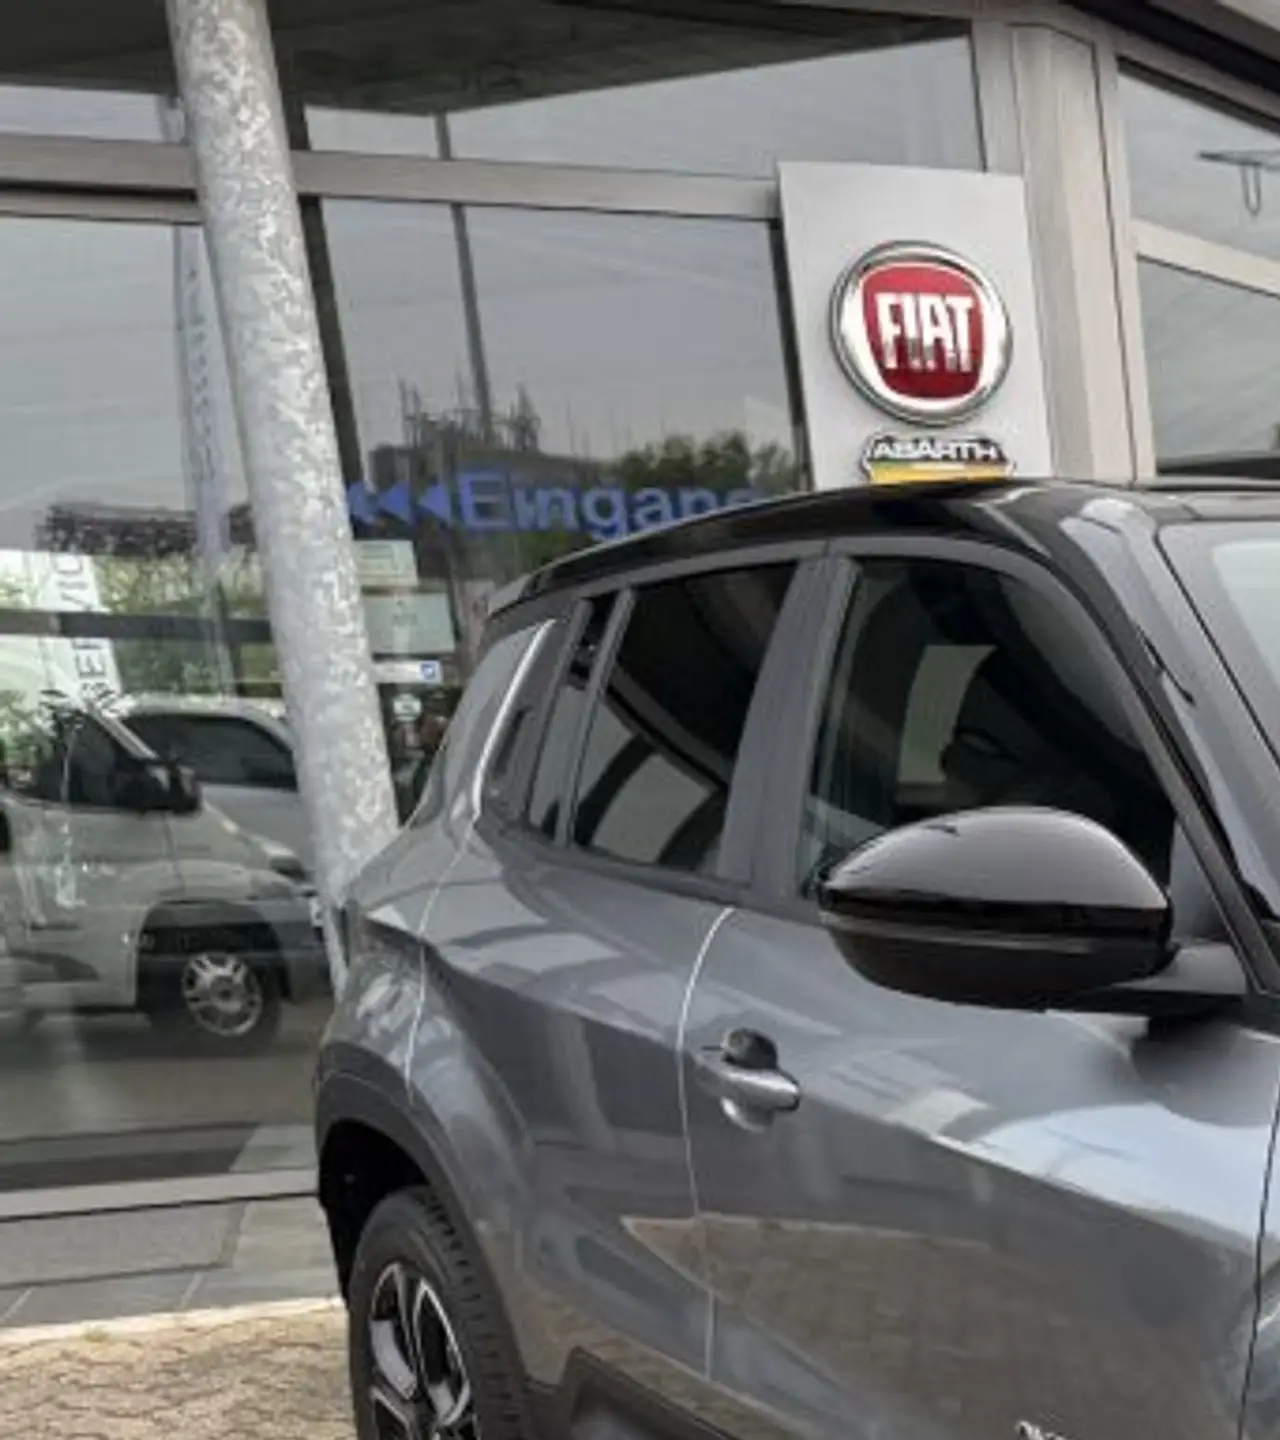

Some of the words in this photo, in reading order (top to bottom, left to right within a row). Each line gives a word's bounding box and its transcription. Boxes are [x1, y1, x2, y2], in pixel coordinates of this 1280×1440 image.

[874, 291, 975, 374] FIAT
[873, 440, 1000, 461] ABARTH
[458, 472, 762, 541] Eingan
